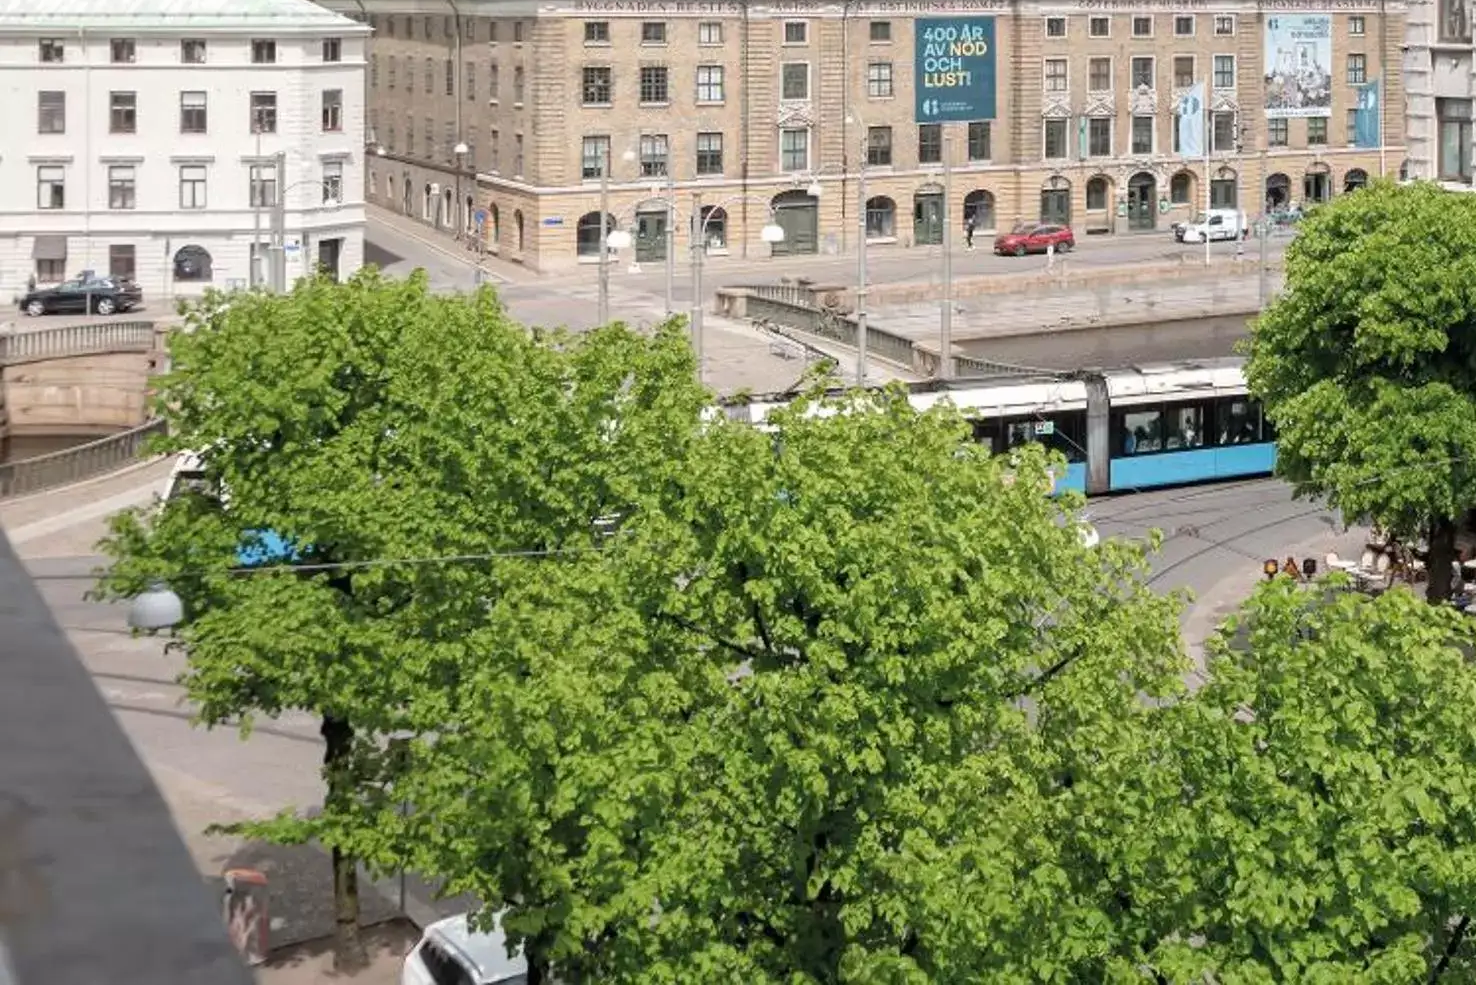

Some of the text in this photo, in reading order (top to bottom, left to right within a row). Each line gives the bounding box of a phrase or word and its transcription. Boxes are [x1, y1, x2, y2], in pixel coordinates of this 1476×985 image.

[924, 24, 984, 41] 400 ÅR
[924, 43, 946, 56] AV
[925, 57, 961, 71] OCH
